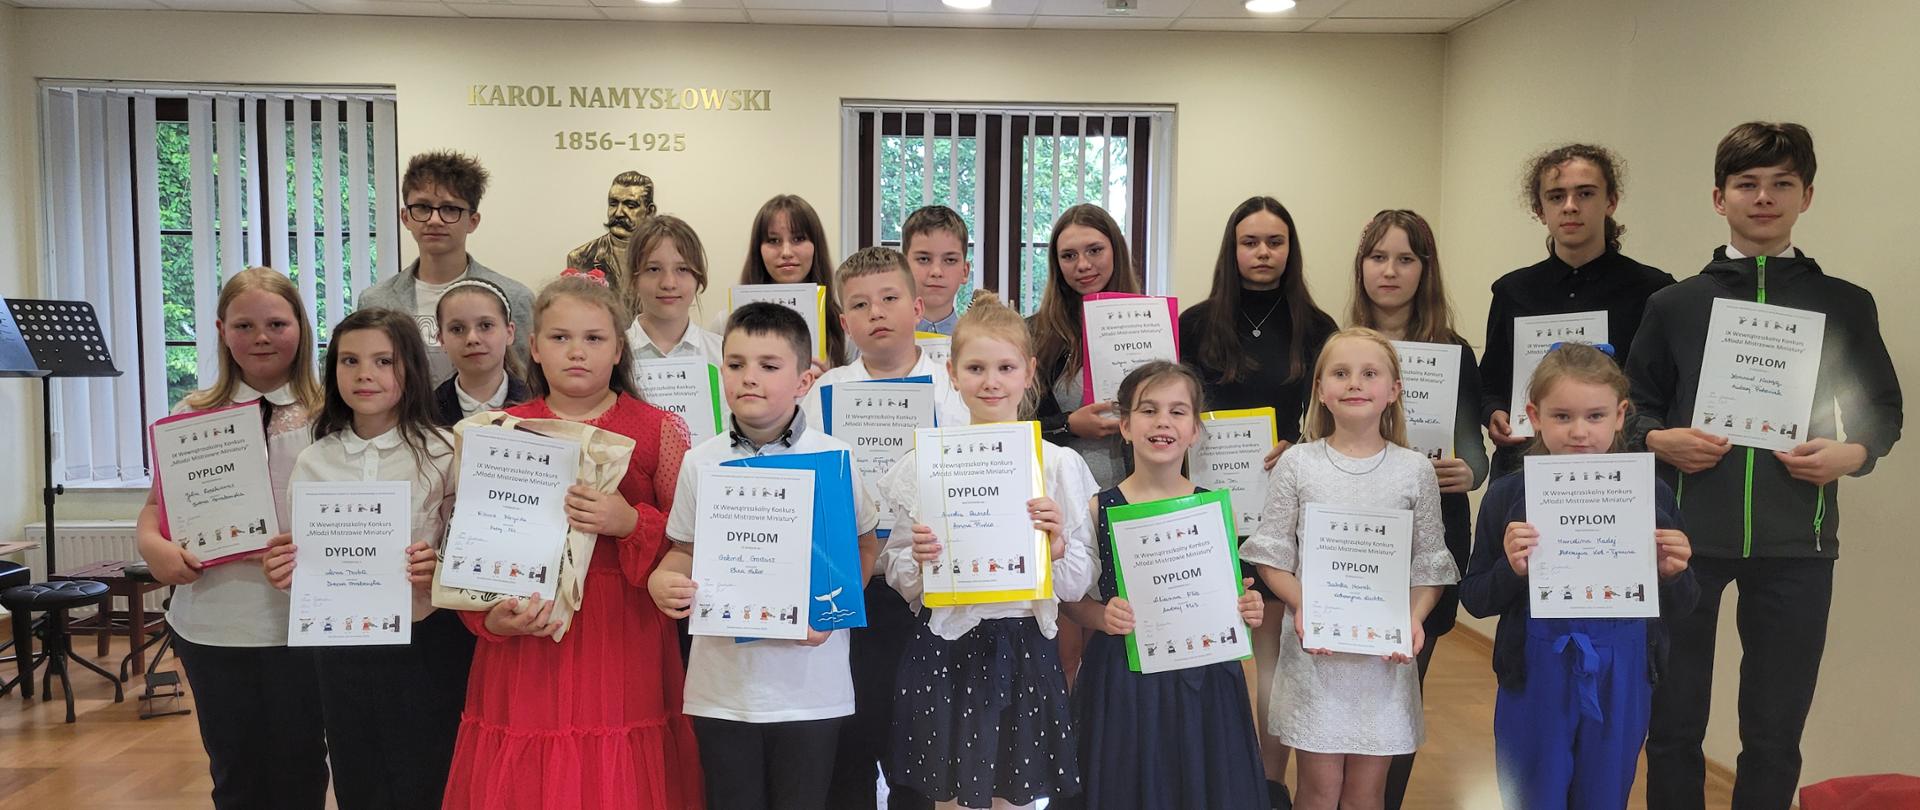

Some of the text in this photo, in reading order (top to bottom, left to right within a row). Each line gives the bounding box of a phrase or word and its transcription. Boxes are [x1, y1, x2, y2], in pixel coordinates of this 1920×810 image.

[468, 84, 771, 111] KAROL NAMYSŁOWSKI
[555, 131, 686, 152] 1856–1925
[1115, 342, 1152, 351] DYPLOM
[1736, 355, 1786, 369] DYPLOM
[858, 437, 902, 446] DYPLOM
[189, 463, 235, 480] DYPLOM
[1213, 462, 1249, 471] DYPLOM
[948, 486, 999, 497] DYPLOM
[489, 490, 539, 506] DYPLOM
[1560, 515, 1615, 525] DYPLOM
[727, 532, 778, 543] DYPLOM
[326, 547, 376, 557] DYPLOM
[1332, 561, 1378, 573] DYPLOM
[1153, 568, 1201, 585] DYPLOM
